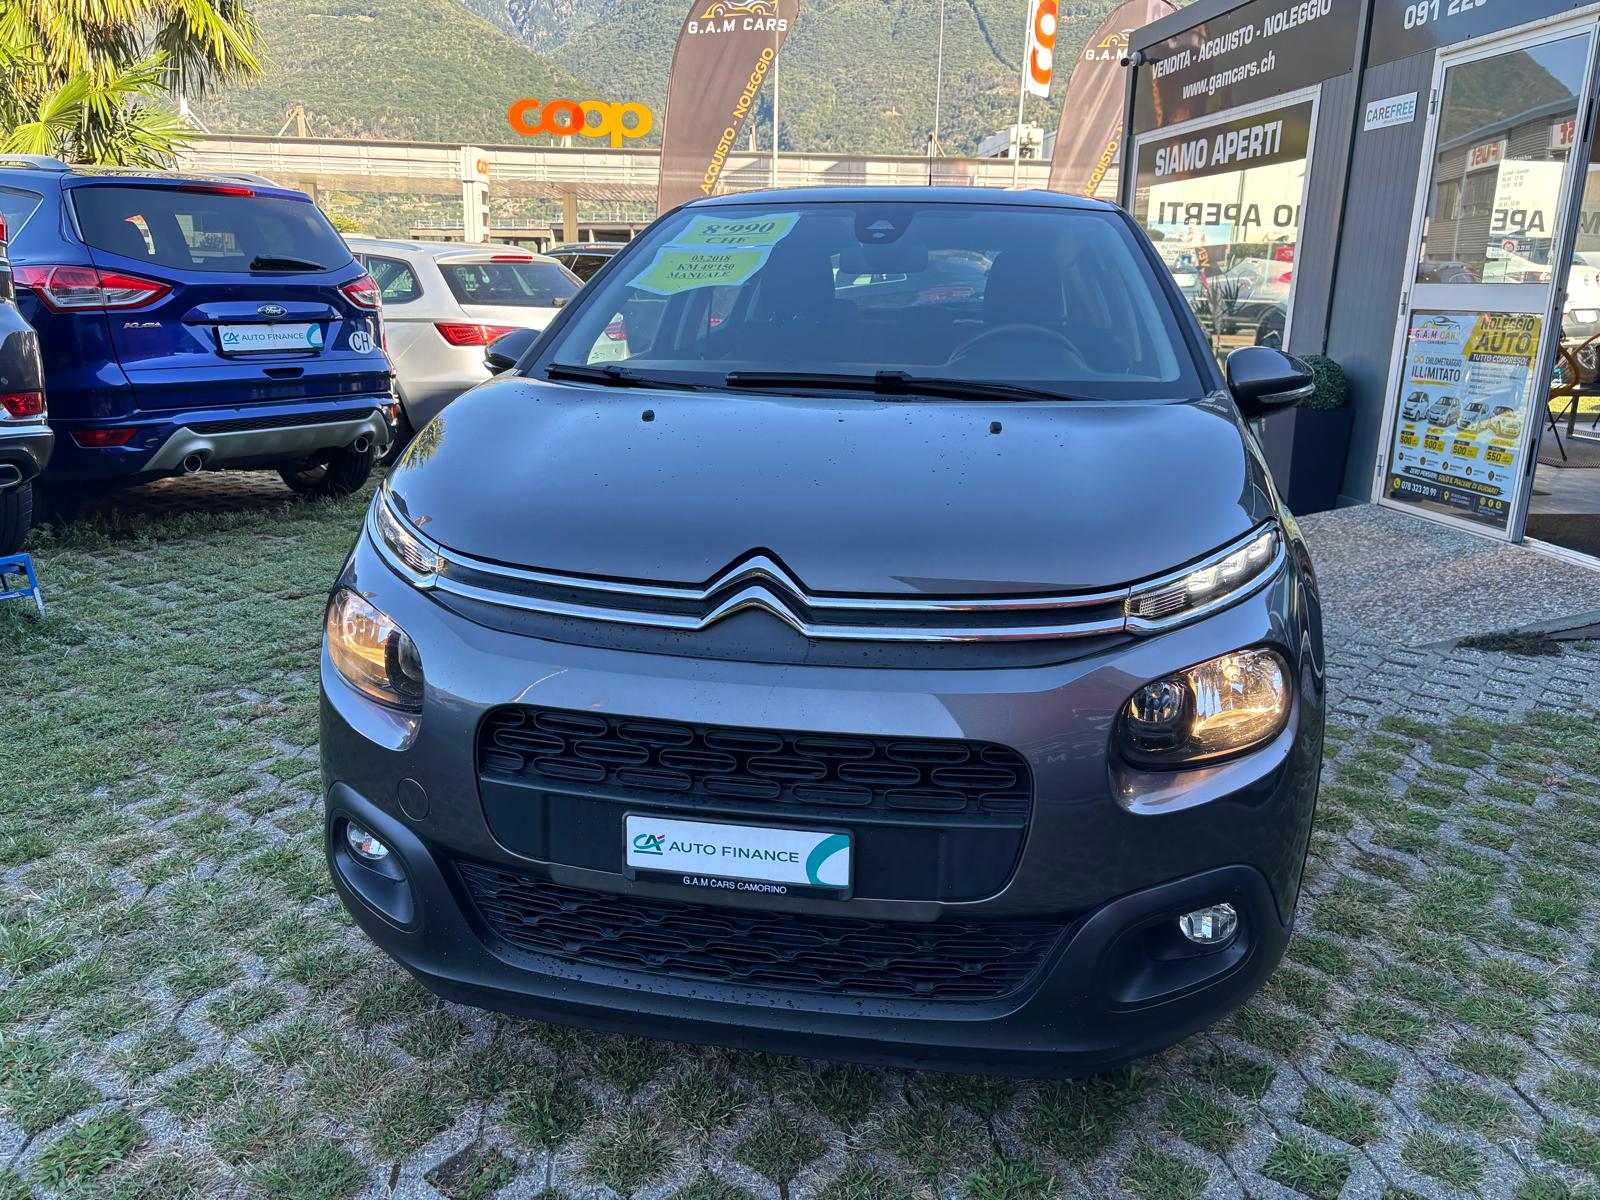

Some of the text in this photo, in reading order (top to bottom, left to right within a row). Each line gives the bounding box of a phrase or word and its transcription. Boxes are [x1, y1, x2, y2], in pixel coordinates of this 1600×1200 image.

[1403, 0, 1440, 30] 091
[687, 18, 788, 34] G.A.M CARS
[1152, 50, 1191, 80] VENDITA
[1198, 24, 1254, 63] ACQUISTO
[1263, 0, 1332, 38] NOLEGGIO
[1085, 49, 1128, 61] G.A.M
[1182, 50, 1276, 100] www.gamcars.ch
[1366, 100, 1415, 122] CAREFREE
[509, 98, 653, 148] coop
[700, 127, 736, 195] ACQUISTO
[733, 47, 775, 119] NOLEGGIO
[1155, 119, 1283, 176] SIAMO APERTI
[1083, 140, 1118, 198] ACQUISTO
[702, 222, 776, 234] 8'990
[691, 255, 732, 263] 03.2018
[666, 271, 731, 280] MANUALE
[1480, 316, 1535, 331] NOLEGGIO
[267, 332, 304, 340] FINANCE
[352, 332, 370, 347] CH
[1475, 331, 1533, 354] AUTO
[1472, 353, 1492, 361] TUTTO
[1411, 365, 1461, 382] ILLIMITATO
[1400, 434, 1412, 445] 500
[1424, 440, 1437, 450] 500
[1453, 445, 1467, 456] 500
[1486, 451, 1502, 462] 550
[1412, 483, 1422, 493] 323
[669, 841, 716, 855] AUTO
[721, 846, 800, 863] FINANCE
[683, 875, 787, 894] G.A.M CARS CAMORINO
